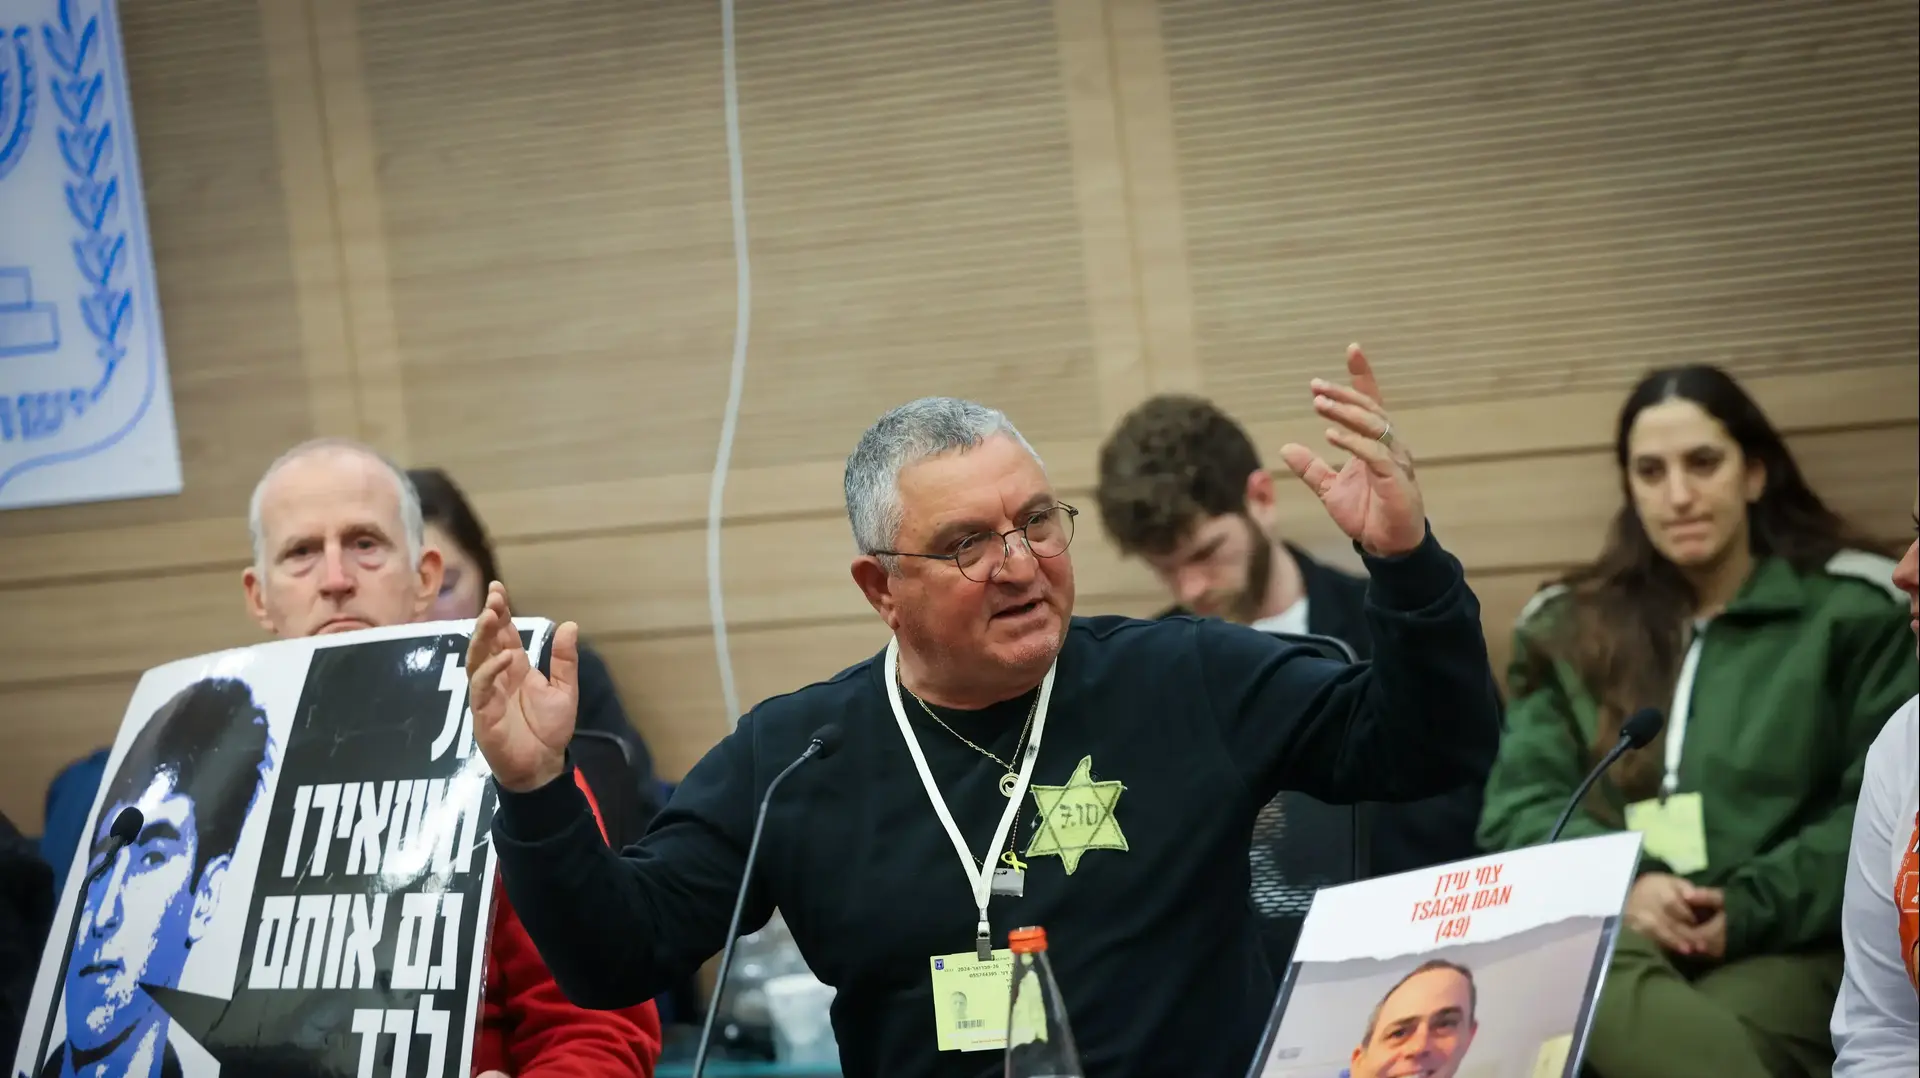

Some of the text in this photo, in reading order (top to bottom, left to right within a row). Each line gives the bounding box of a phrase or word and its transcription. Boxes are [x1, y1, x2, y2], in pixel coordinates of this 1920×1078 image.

[431, 652, 474, 762] ל
[281, 778, 485, 878] תשאירו
[1059, 803, 1099, 829] 7.10
[1434, 864, 1503, 897] צחי עידן
[1411, 885, 1512, 922] TSACHI IDAN
[248, 893, 464, 990] גם אותם
[1436, 916, 1471, 944] (49)
